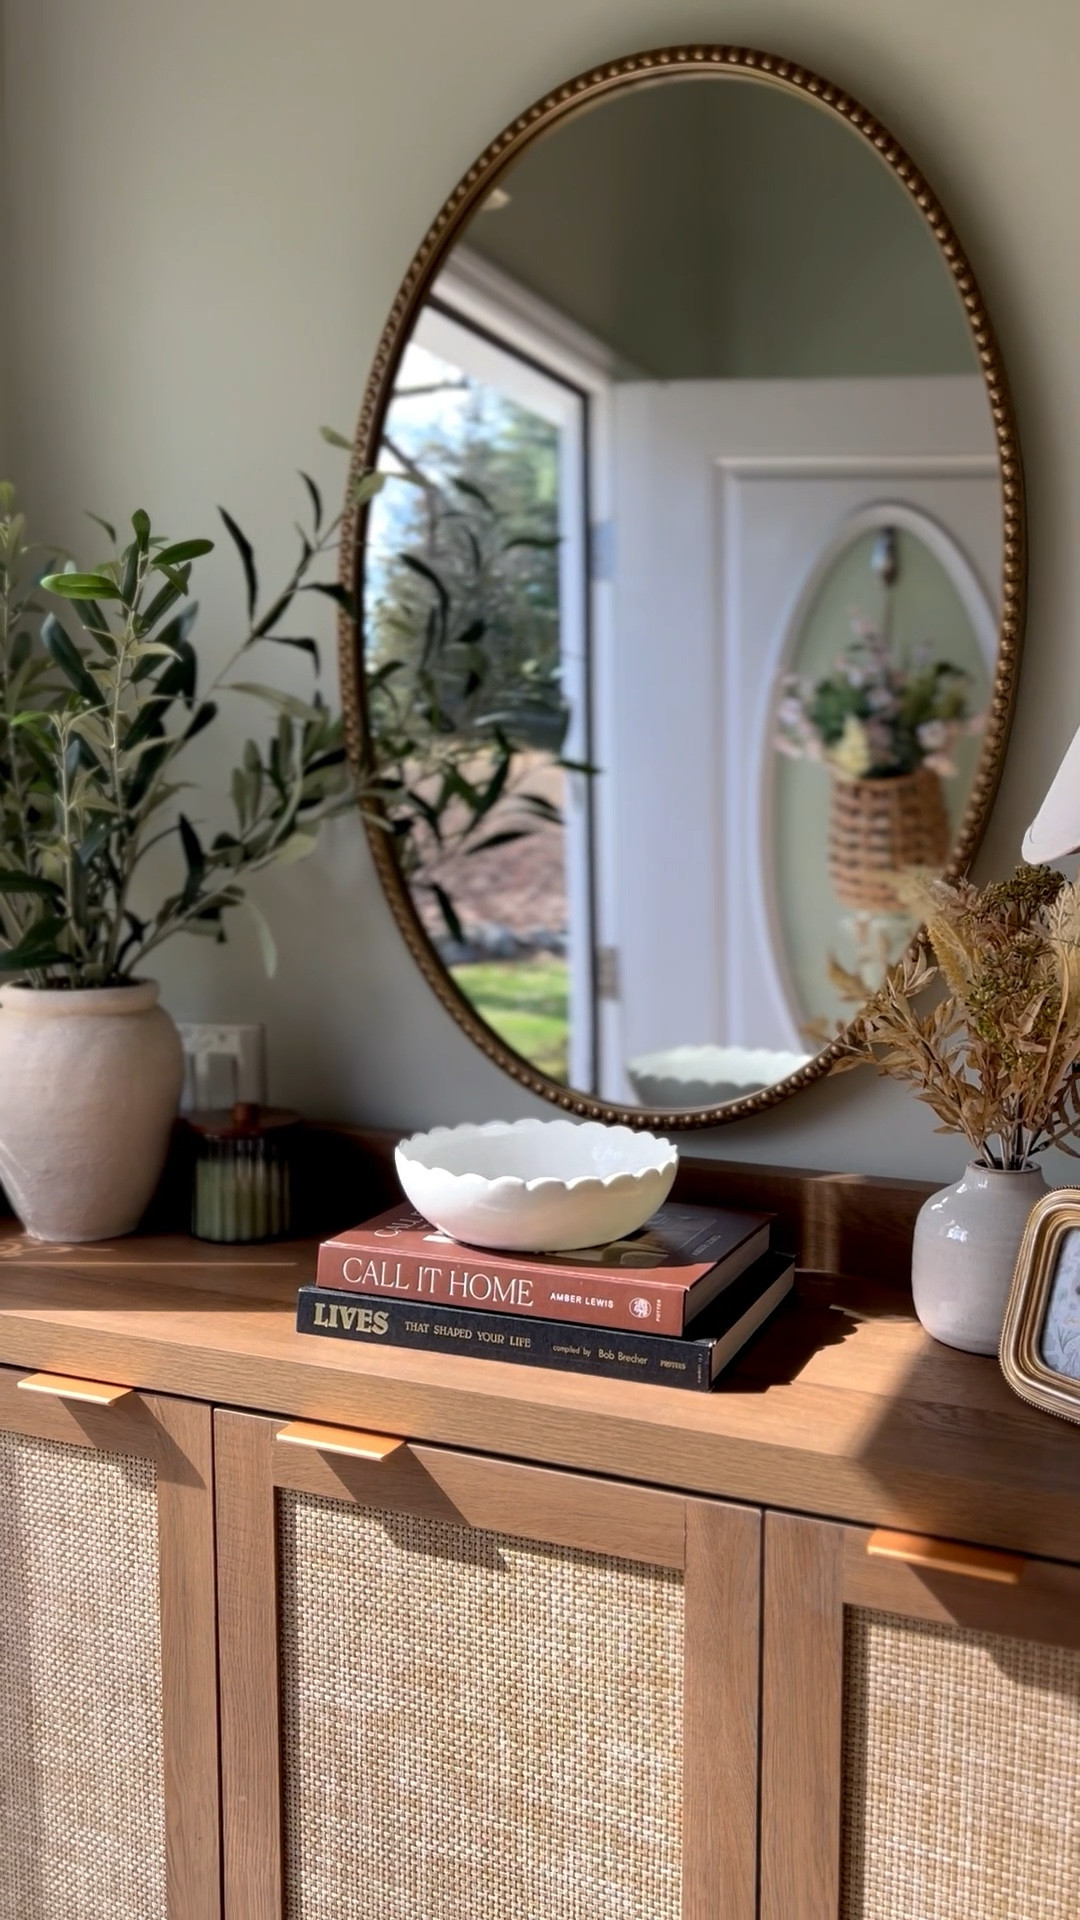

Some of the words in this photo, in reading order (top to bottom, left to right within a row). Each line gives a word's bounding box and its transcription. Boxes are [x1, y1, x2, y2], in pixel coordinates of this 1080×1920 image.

[342, 1257, 410, 1290] CALL
[417, 1266, 443, 1293] IT
[449, 1270, 534, 1307] HOME
[550, 1292, 582, 1304] AMBER
[585, 1297, 614, 1309] LEWIS
[313, 1302, 389, 1335] LIVES
[404, 1321, 430, 1333] THAT
[433, 1325, 473, 1339] SHAPED
[477, 1331, 505, 1344] YOUR
[509, 1336, 531, 1348] LIFE
[552, 1345, 581, 1354] compiled
[583, 1347, 592, 1357] by
[598, 1349, 615, 1360] Bob
[617, 1351, 648, 1365] Brecher
